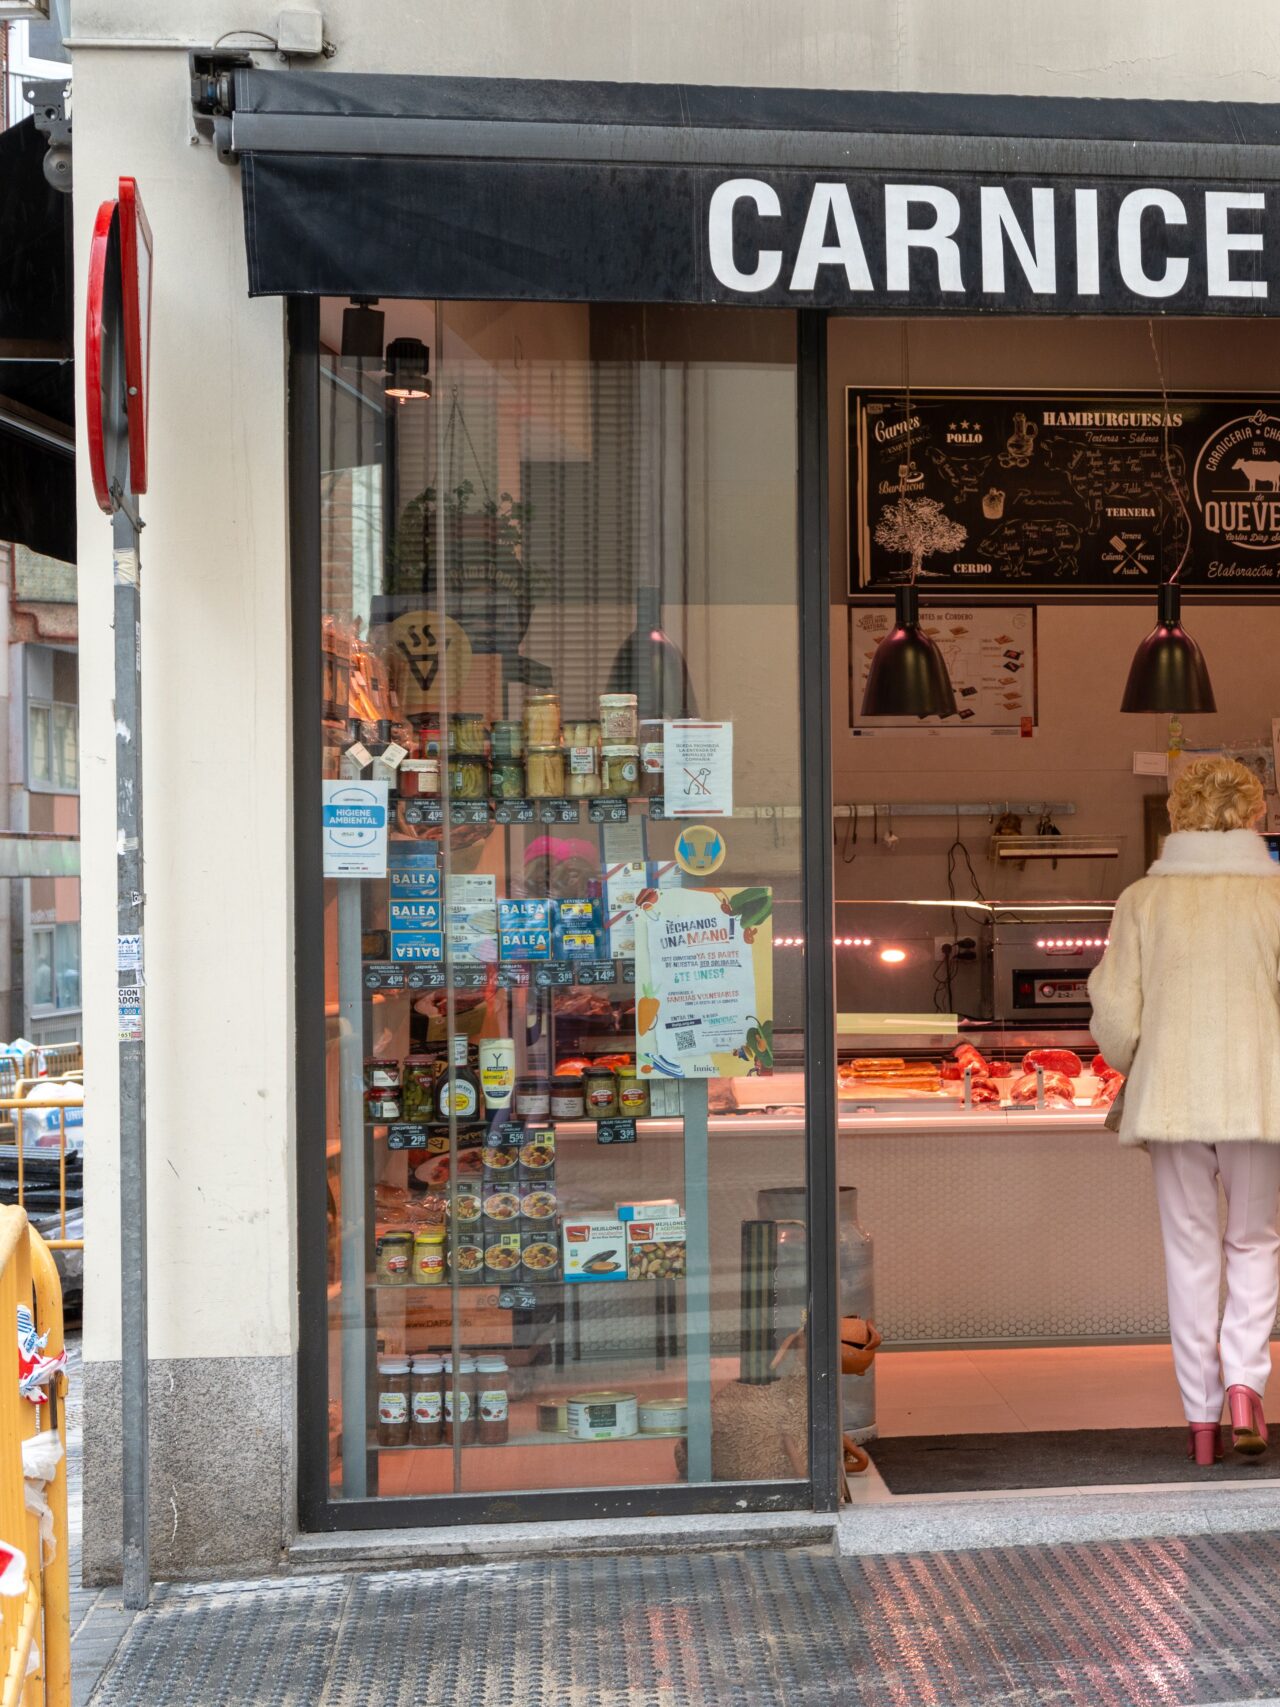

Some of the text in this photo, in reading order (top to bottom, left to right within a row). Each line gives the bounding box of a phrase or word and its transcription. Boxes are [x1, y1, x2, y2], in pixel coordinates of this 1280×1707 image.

[1043, 412, 1183, 427] HAMBURGUESAS
[1249, 409, 1269, 425] La
[875, 415, 920, 443] Carnes
[946, 433, 983, 444] POLLO
[1085, 432, 1159, 443] Texturas Sabores
[1206, 427, 1253, 472] CARNICERIA
[1105, 508, 1156, 517] TERNERA
[1137, 552, 1155, 561] Fresca
[953, 563, 992, 574] CERDO
[944, 613, 974, 621] CORDERO
[336, 809, 371, 817] HIGIENE
[329, 817, 378, 825] AMBIENTAL
[392, 874, 436, 884] BALEA
[392, 905, 436, 916] BALEA
[501, 904, 545, 914] BALEA
[503, 934, 547, 945] BALEA
[660, 934, 686, 949] UNA
[396, 947, 440, 958] BALEA
